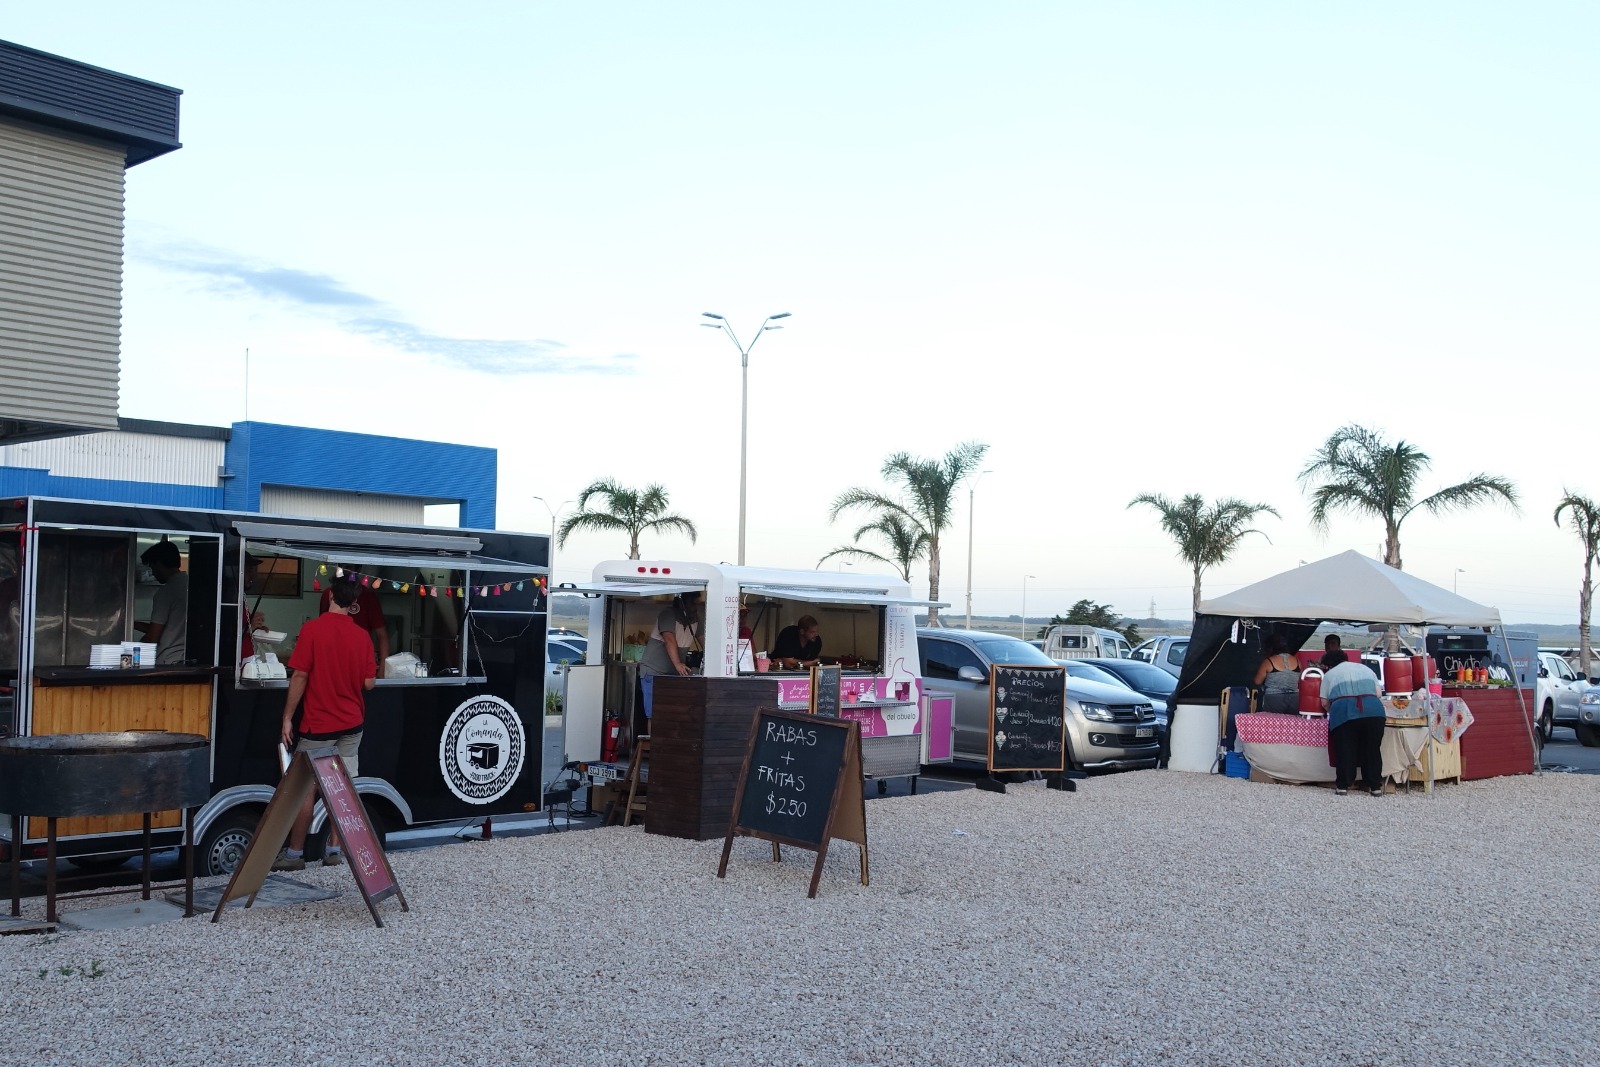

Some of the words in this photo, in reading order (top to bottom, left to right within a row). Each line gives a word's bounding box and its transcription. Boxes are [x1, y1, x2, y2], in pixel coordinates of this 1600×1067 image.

[886, 713, 896, 721] del
[896, 712, 916, 720] abuelo
[465, 725, 504, 742] Comanda
[765, 721, 817, 746] RABAS
[780, 750, 795, 766] +
[757, 765, 806, 792] FRITAS
[338, 798, 352, 813] DE
[765, 790, 807, 818] $250
